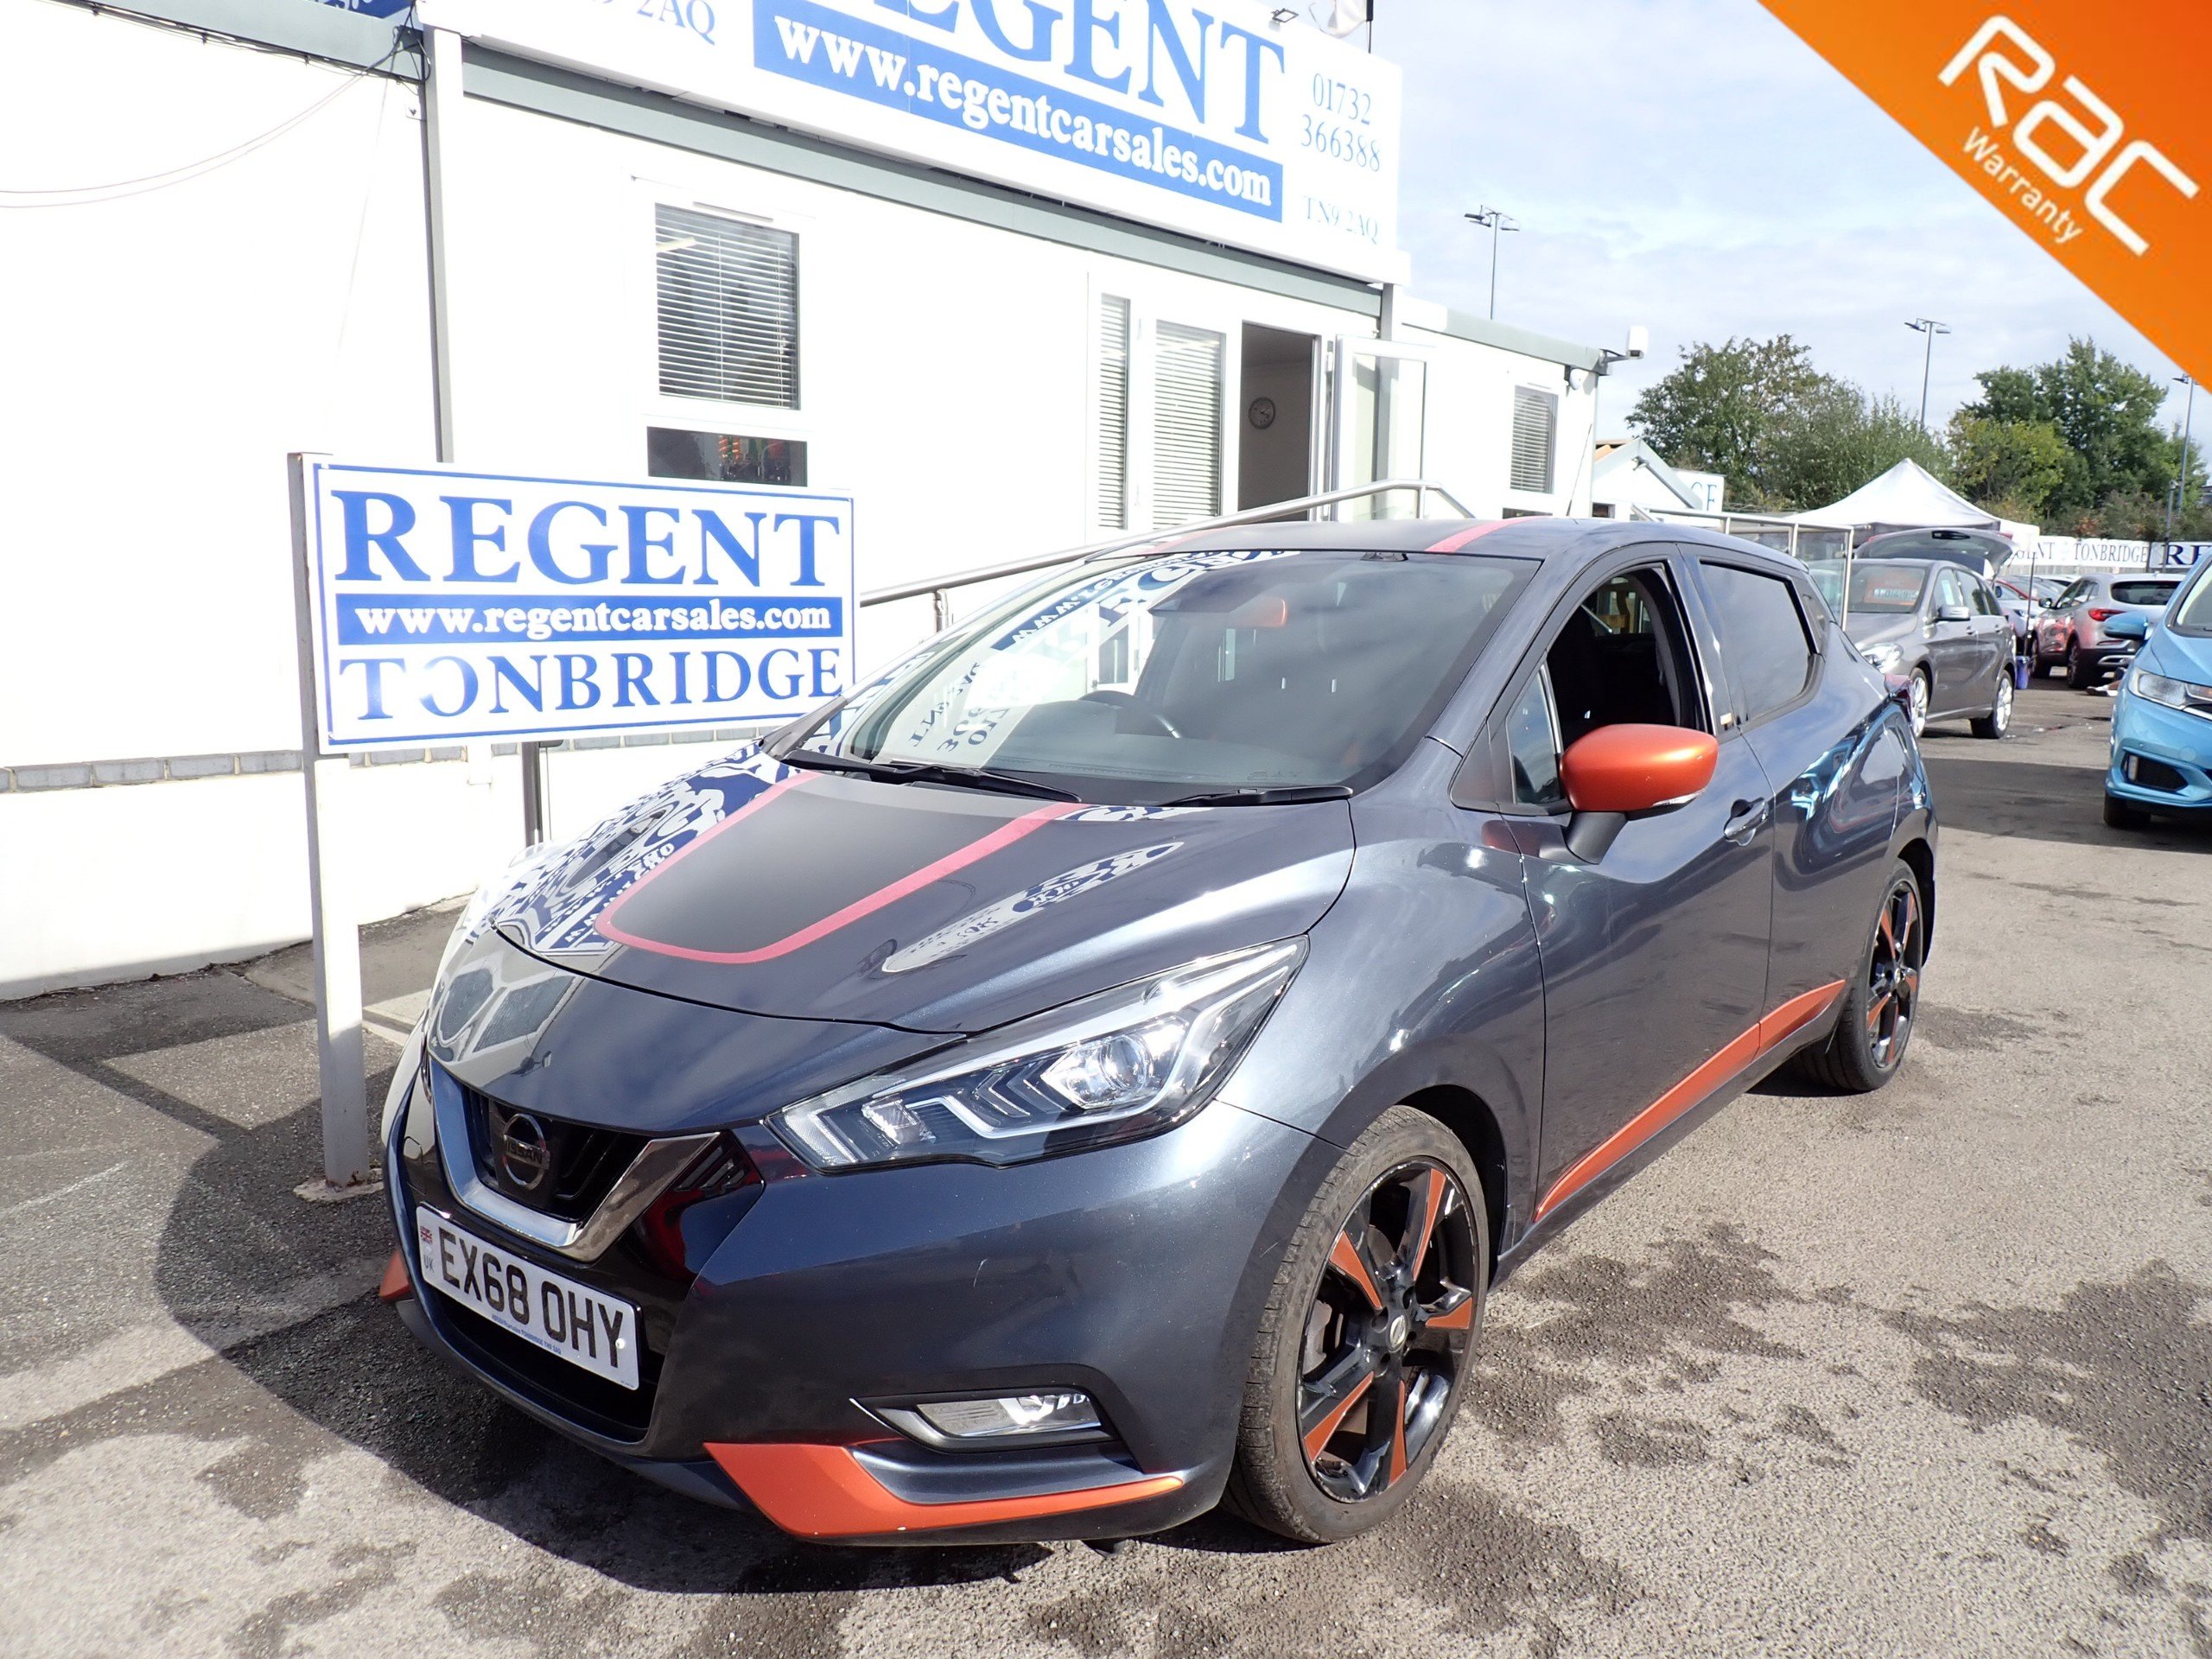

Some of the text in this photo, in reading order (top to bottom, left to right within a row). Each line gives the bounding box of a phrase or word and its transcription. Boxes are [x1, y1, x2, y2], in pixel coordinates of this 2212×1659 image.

[773, 14, 1273, 207] www.regentcarsales.com
[1313, 73, 1371, 125] 01732
[1300, 113, 1380, 172] 366388
[330, 489, 841, 588] REGENT
[2073, 543, 2149, 563] TONBRIDGE
[354, 598, 831, 641] www.regentcarsales.com
[423, 1254, 435, 1274] UK
[438, 1226, 624, 1369] EX68 OHY
